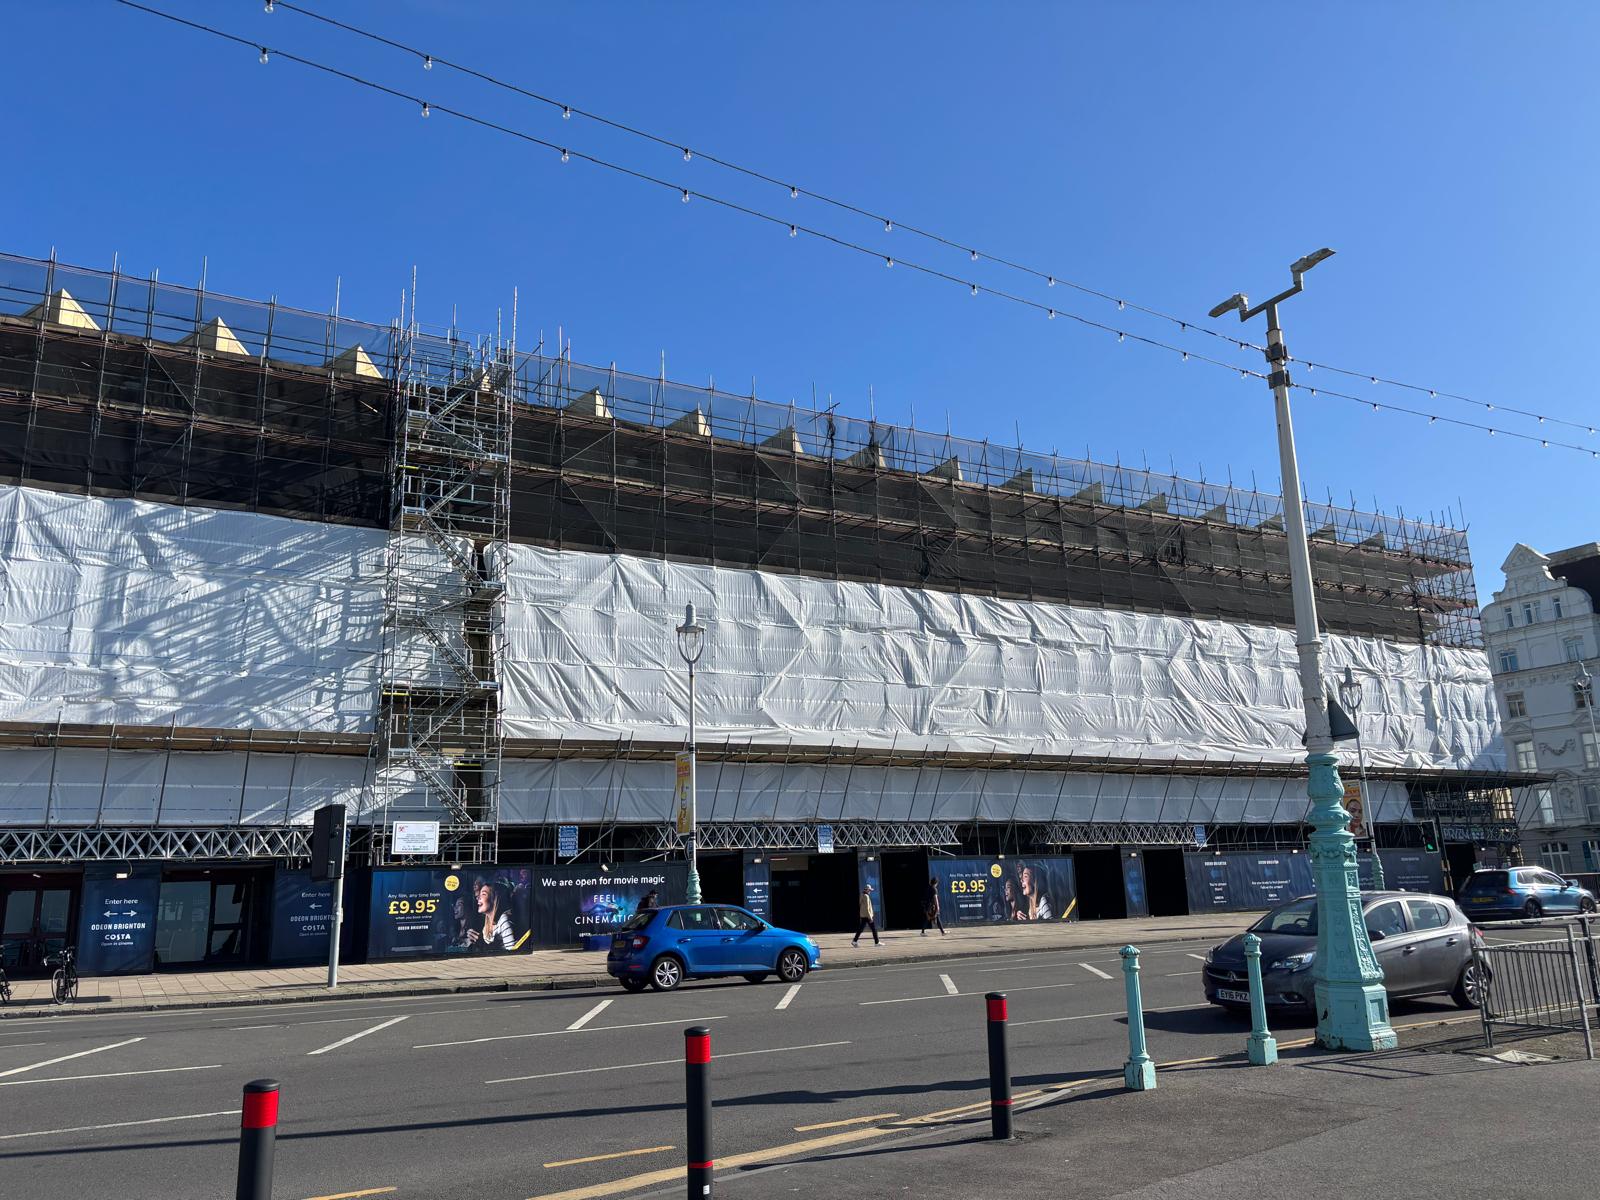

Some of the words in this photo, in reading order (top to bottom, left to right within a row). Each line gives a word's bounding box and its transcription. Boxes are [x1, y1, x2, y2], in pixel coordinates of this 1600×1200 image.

[542, 878, 556, 886] We
[576, 878, 596, 887] open
[599, 876, 612, 885] for
[614, 875, 638, 884] movie
[640, 875, 665, 885] magic
[594, 894, 616, 903] FEEL
